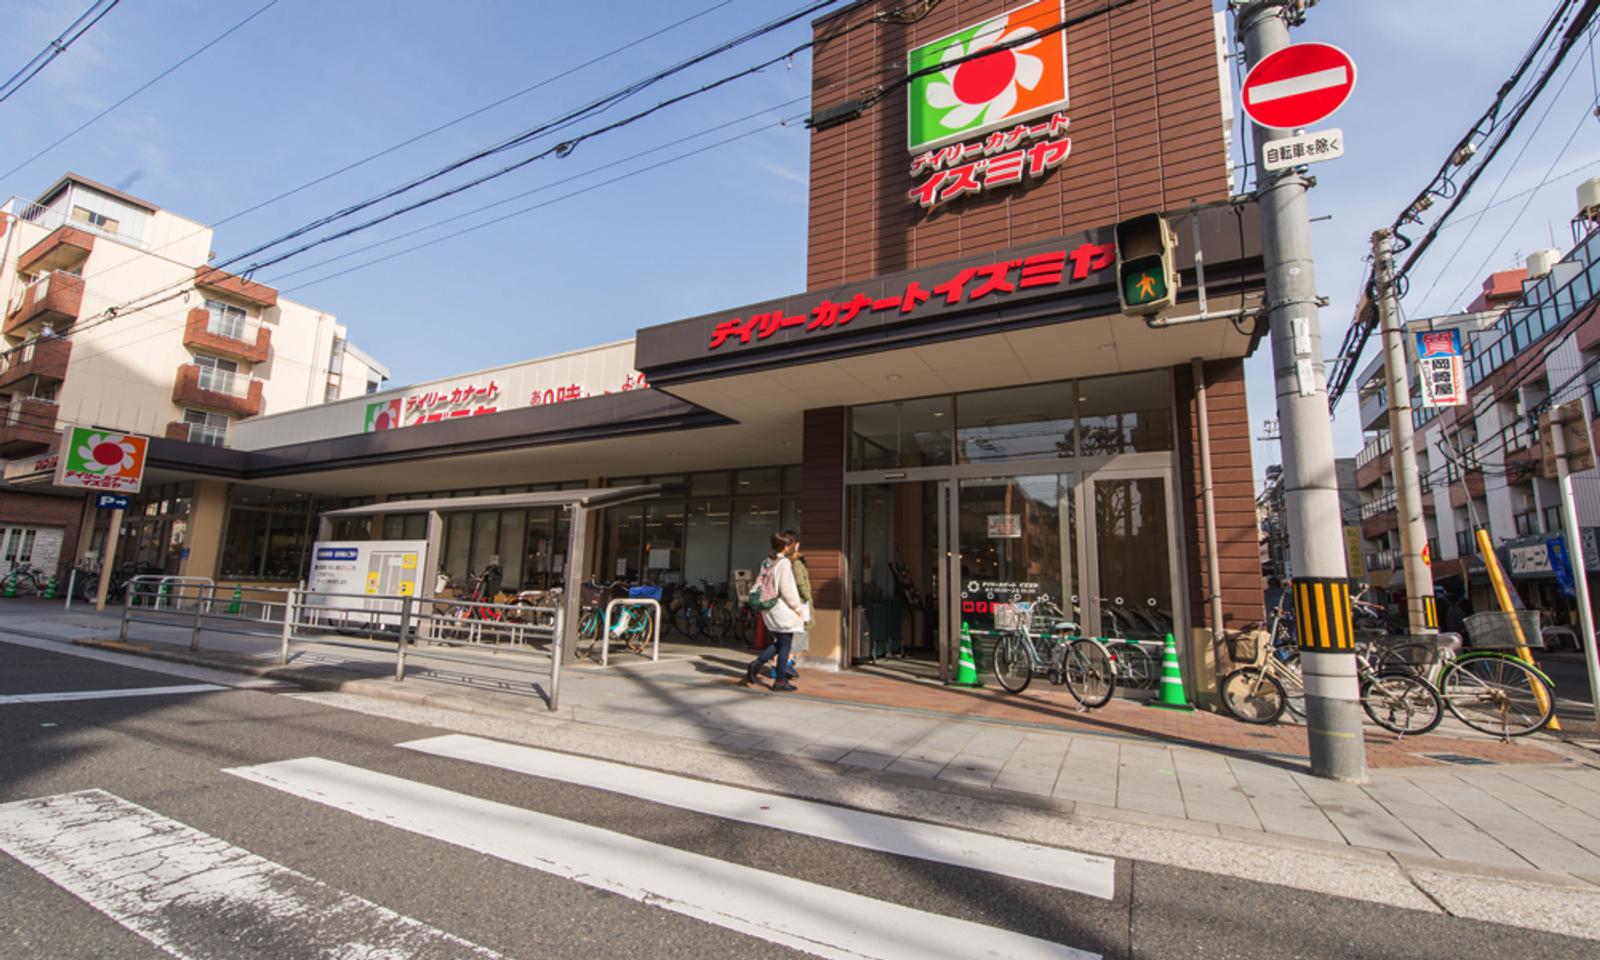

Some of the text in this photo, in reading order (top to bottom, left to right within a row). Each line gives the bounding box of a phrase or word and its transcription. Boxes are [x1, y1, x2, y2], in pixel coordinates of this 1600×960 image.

[1267, 138, 1339, 163] 自転車を除く
[908, 137, 1071, 206] イズミヤ
[1423, 331, 1457, 357] 質
[99, 495, 115, 506] P
